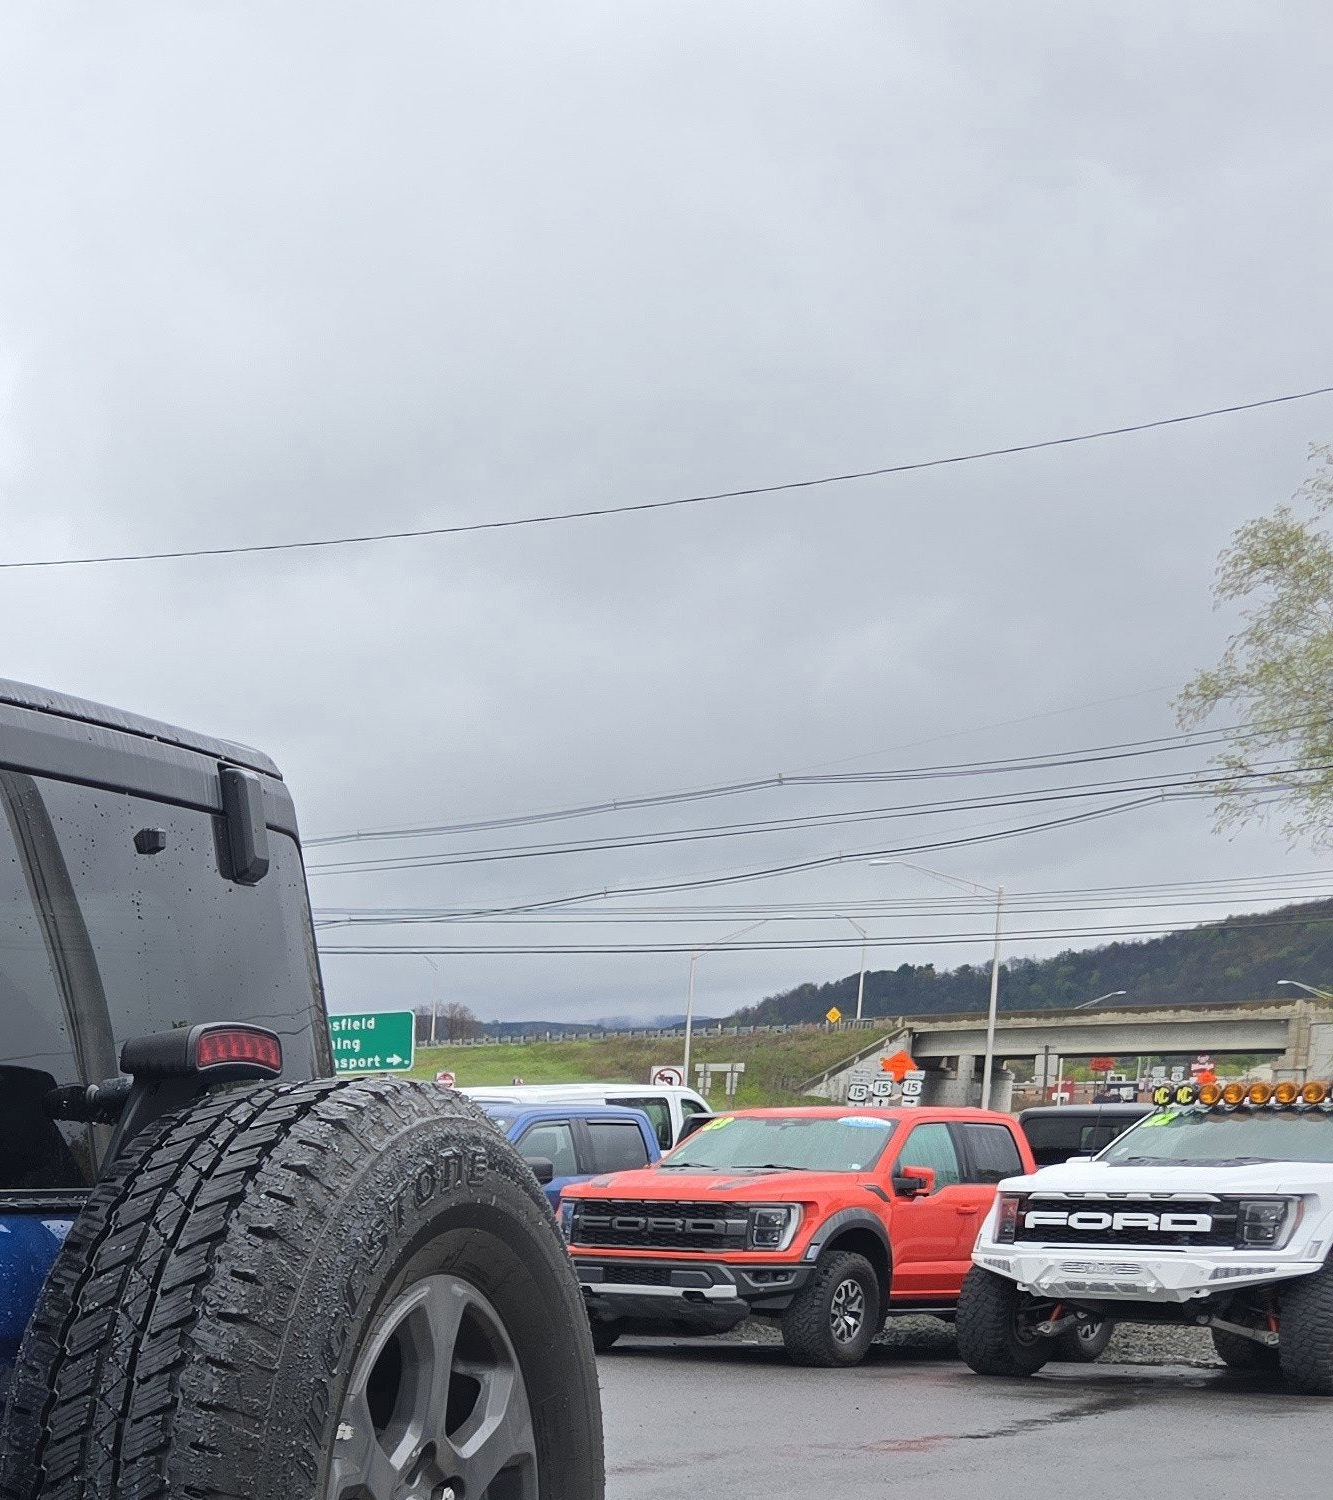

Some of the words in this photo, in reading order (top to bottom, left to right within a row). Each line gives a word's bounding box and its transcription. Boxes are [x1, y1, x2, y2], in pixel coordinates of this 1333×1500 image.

[877, 1083, 889, 1093] 15
[907, 1082, 918, 1092] 15
[578, 1214, 727, 1235] FORD
[1024, 1211, 1213, 1233] FORD
